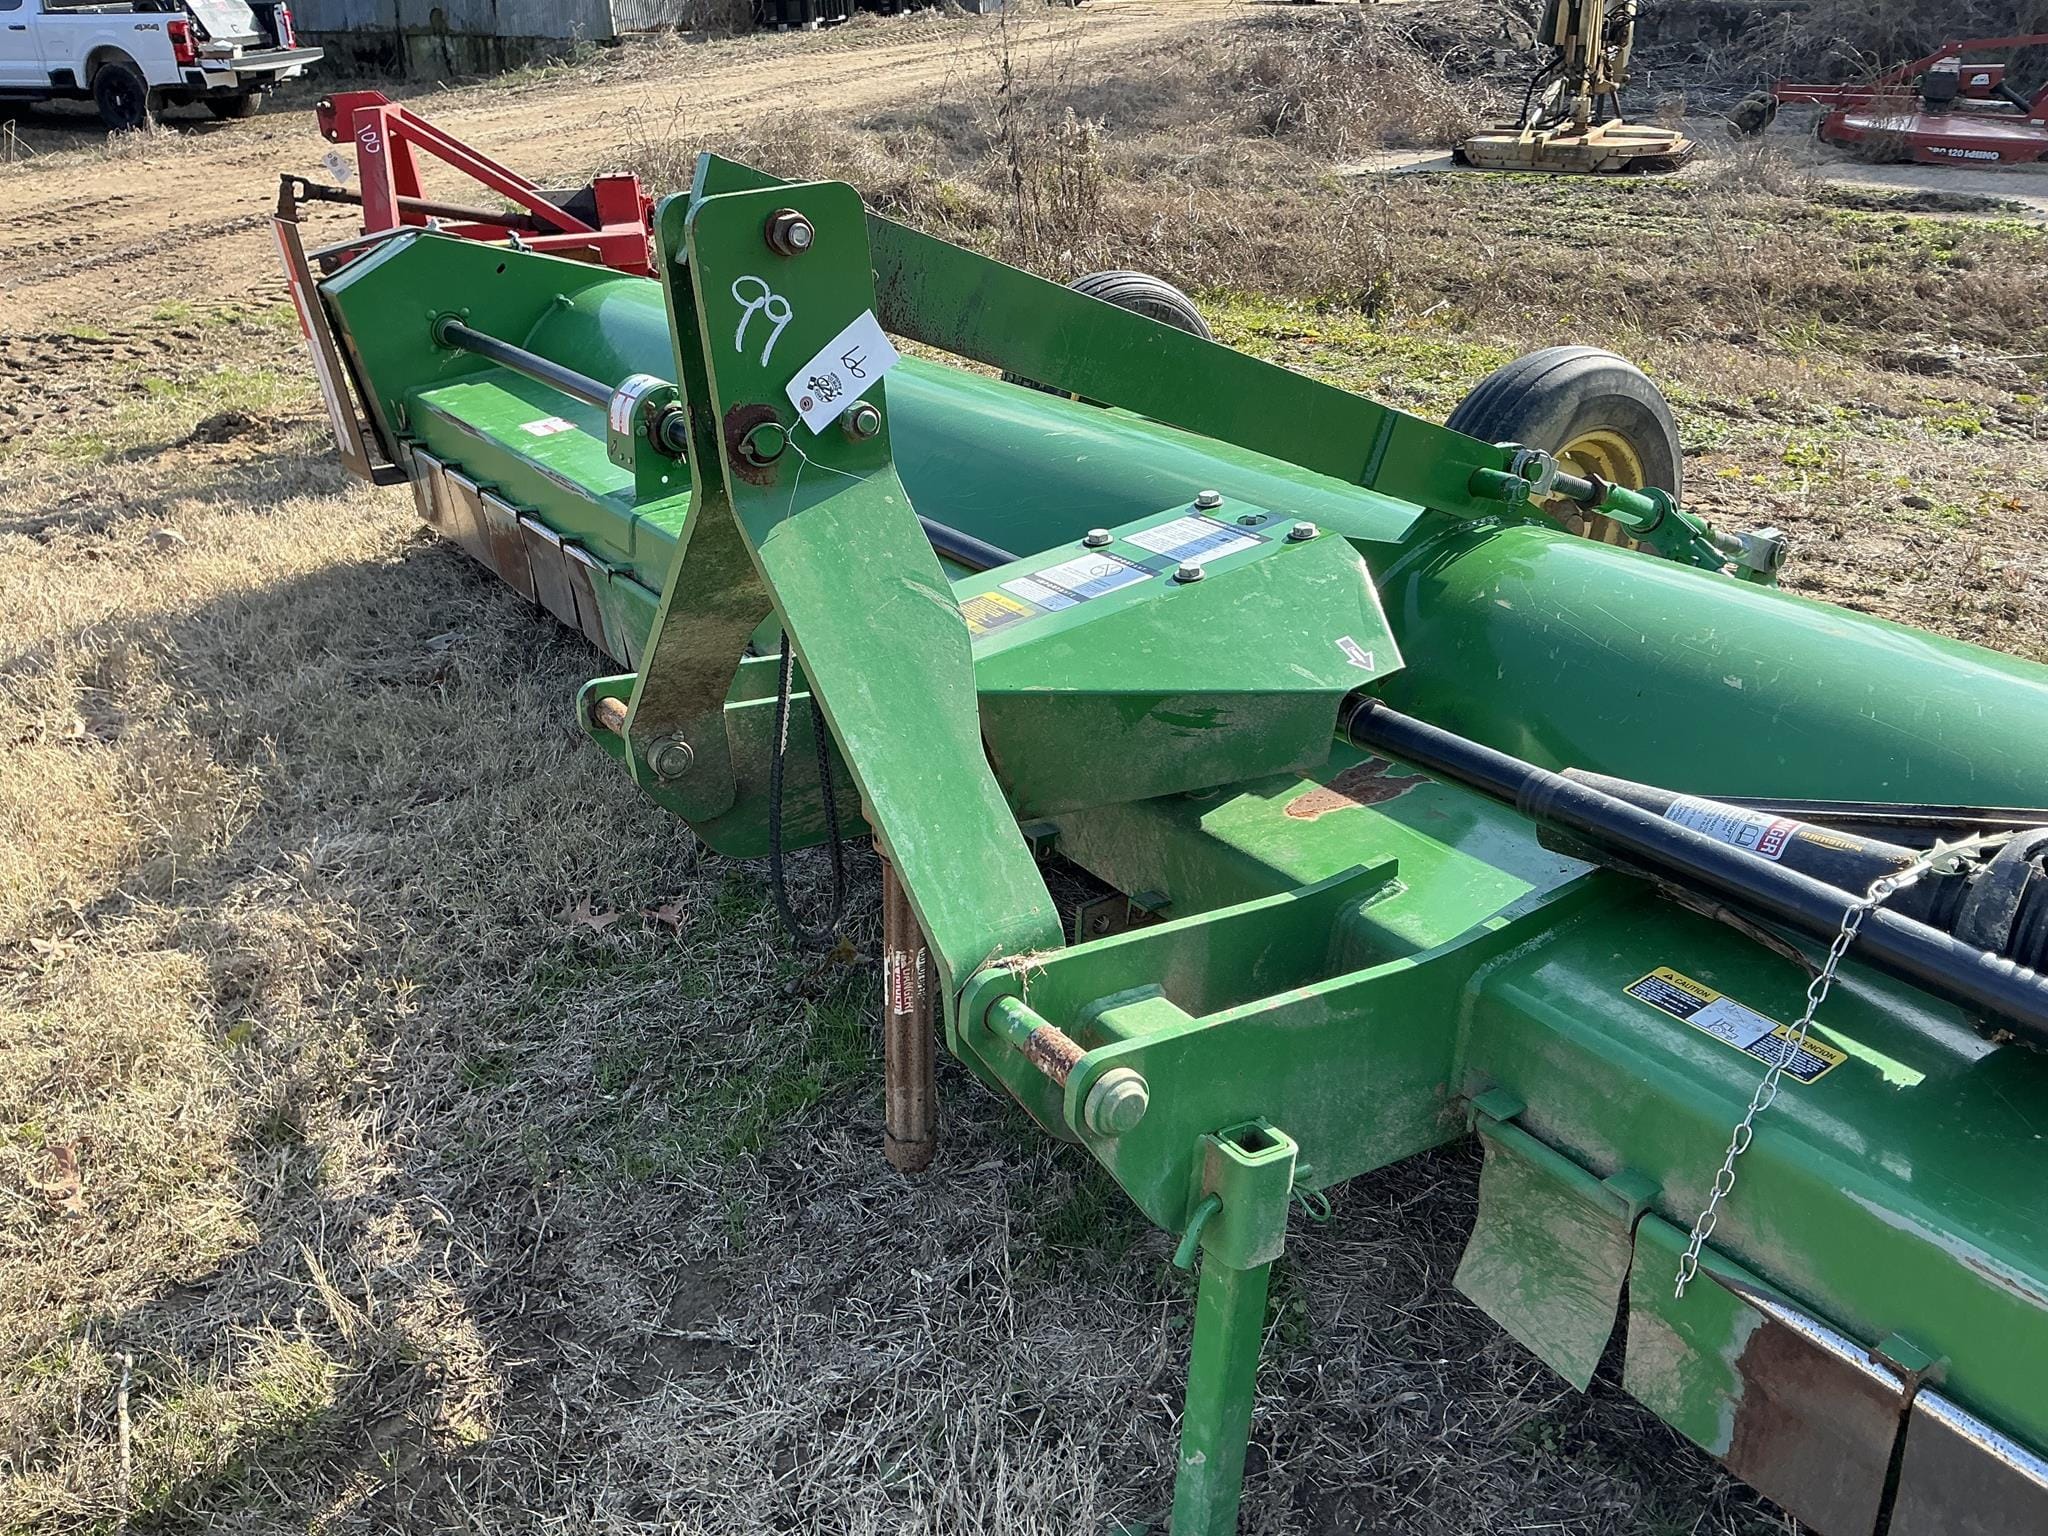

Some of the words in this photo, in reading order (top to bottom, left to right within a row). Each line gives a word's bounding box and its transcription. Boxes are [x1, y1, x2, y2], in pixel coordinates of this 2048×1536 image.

[357, 123, 381, 154] 100
[731, 275, 793, 368] 99
[1674, 977, 1711, 999] CAUTION
[1794, 1036, 1837, 1060] AENCION
